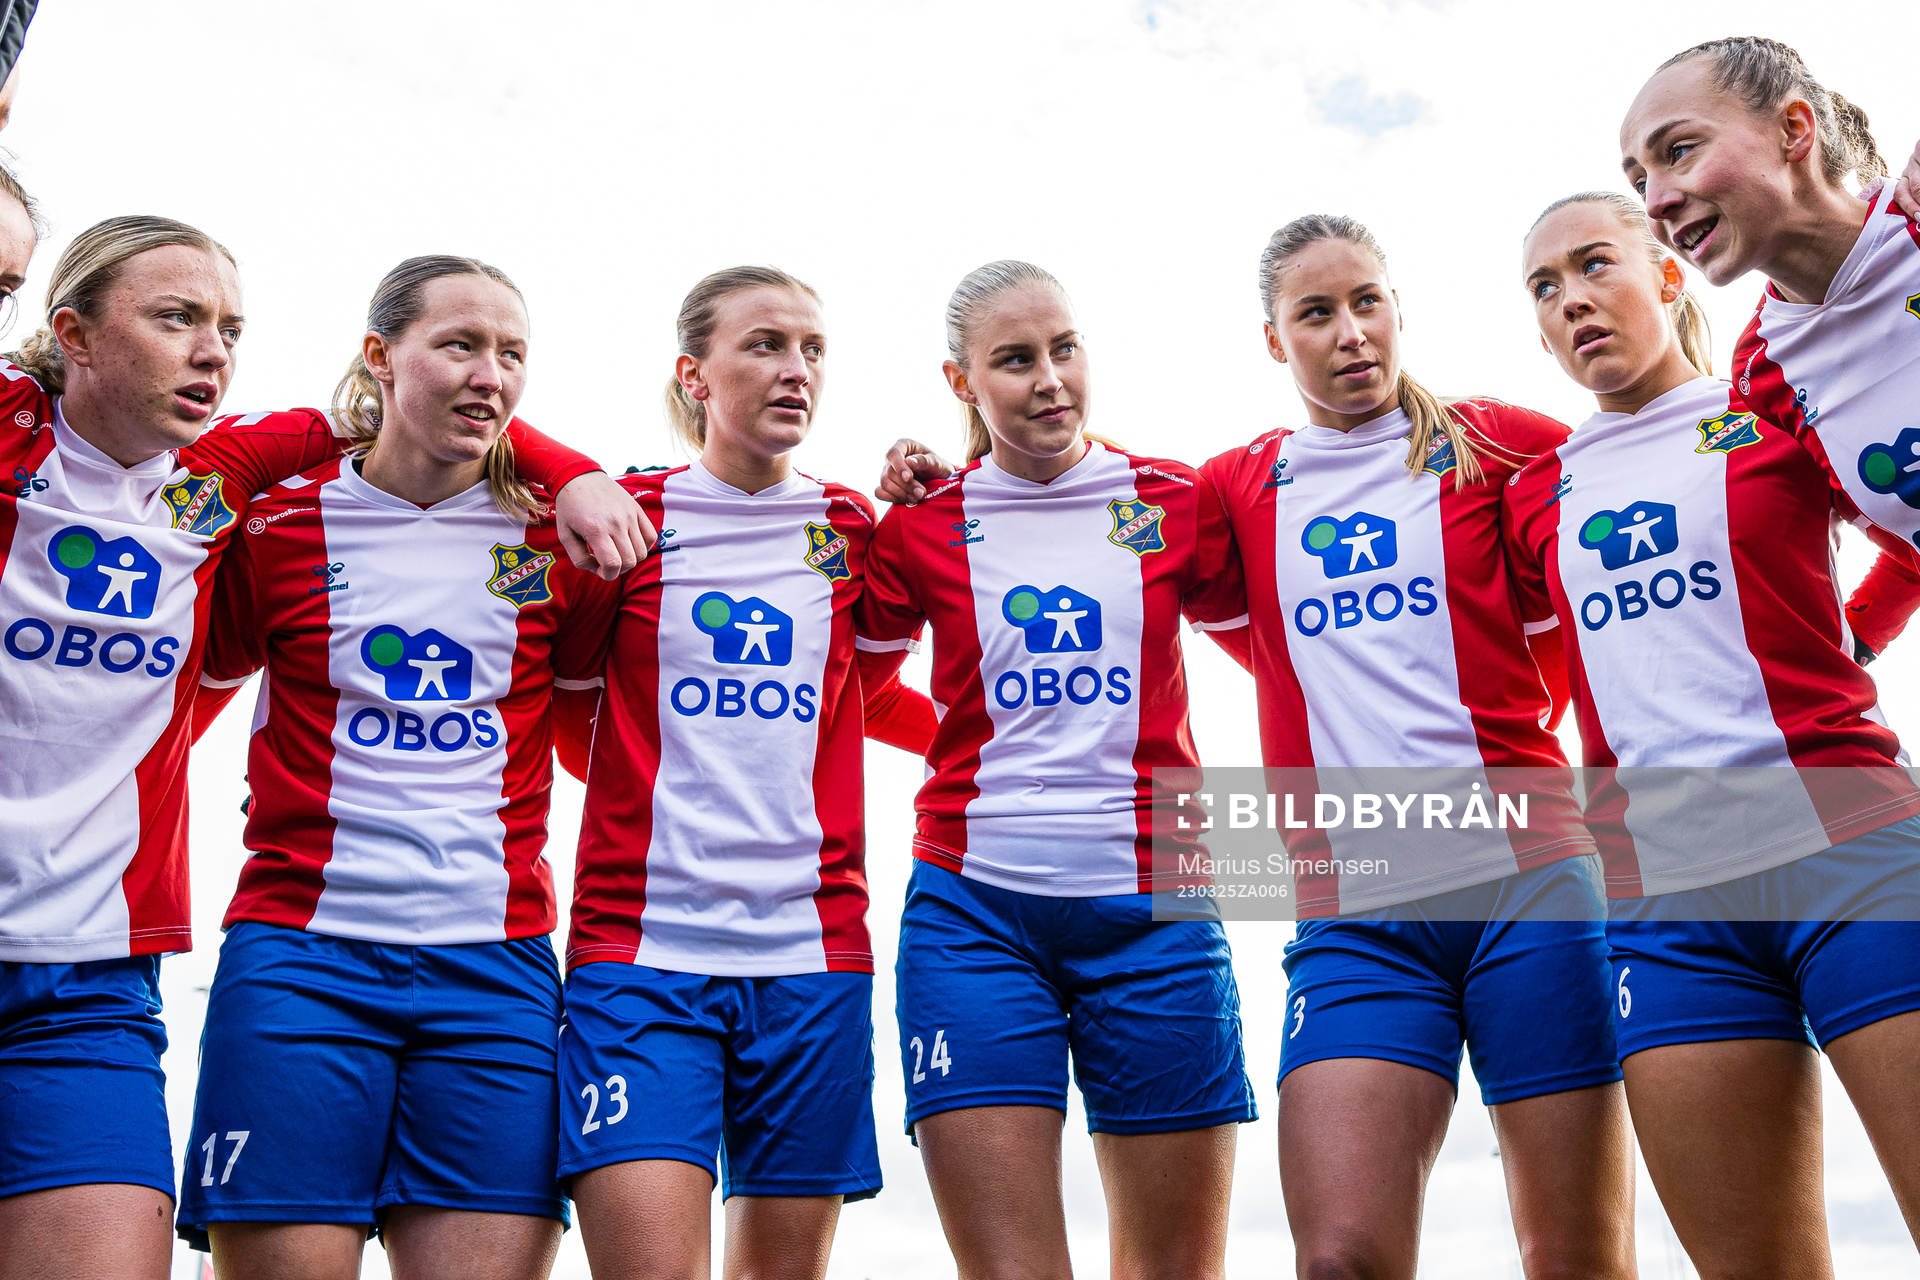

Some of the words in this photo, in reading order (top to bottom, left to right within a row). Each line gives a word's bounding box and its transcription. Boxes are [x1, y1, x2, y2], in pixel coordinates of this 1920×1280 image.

[186, 490, 209, 521] LYN
[206, 478, 216, 490] 96
[1126, 515, 1150, 535] LYN
[507, 563, 536, 583] LYN
[819, 543, 840, 559] LYN
[1295, 576, 1438, 637] OBOS
[1581, 560, 1722, 631] OBOS
[4, 617, 180, 678] OBOS
[671, 677, 816, 723] OBOS
[995, 666, 1132, 710] OBOS
[348, 707, 499, 752] OBOS
[1618, 966, 1632, 1019] 6
[1289, 996, 1306, 1039] 3
[910, 1029, 952, 1085] 24
[580, 1074, 629, 1135] 23
[200, 1130, 250, 1188] 17
